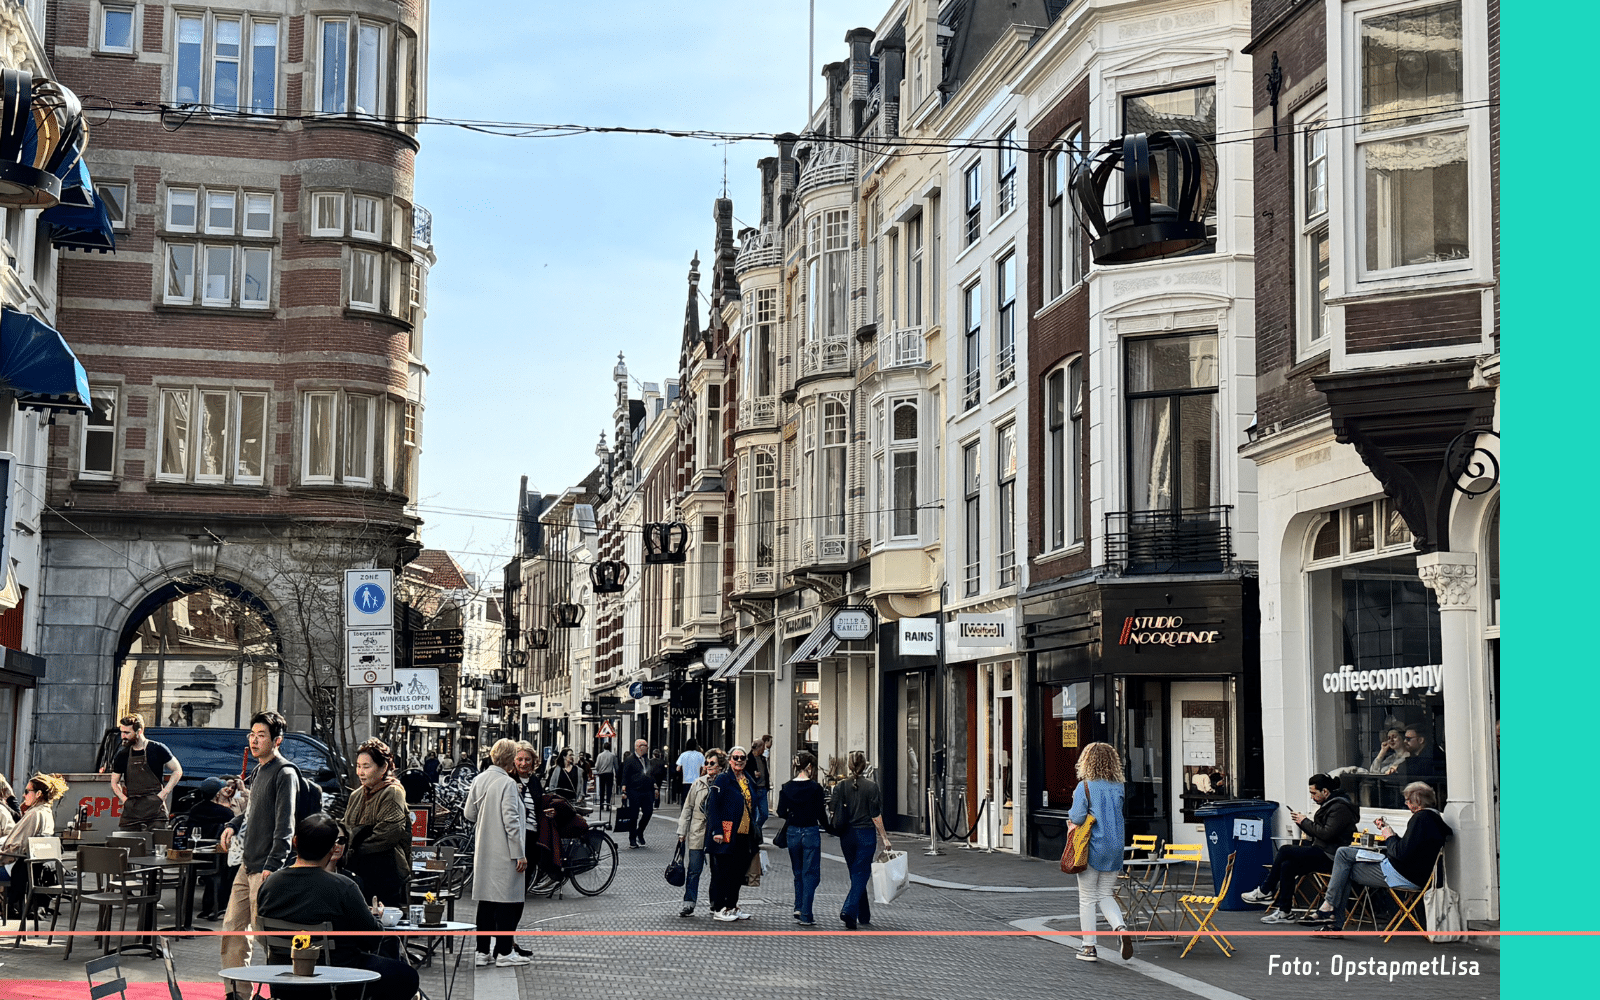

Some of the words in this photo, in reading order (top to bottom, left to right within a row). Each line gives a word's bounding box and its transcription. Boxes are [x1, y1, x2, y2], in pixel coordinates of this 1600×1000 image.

[838, 617, 859, 625] DILLE
[860, 617, 867, 625] &
[1132, 616, 1183, 631] STUDIO
[837, 624, 868, 632] KAMILLE
[968, 626, 997, 634] Wolford
[905, 631, 934, 642] RAINS
[1323, 665, 1444, 694] coffeecompany
[1375, 697, 1421, 706] chocolate
[671, 707, 698, 715] PAUW
[1240, 823, 1257, 837] B1
